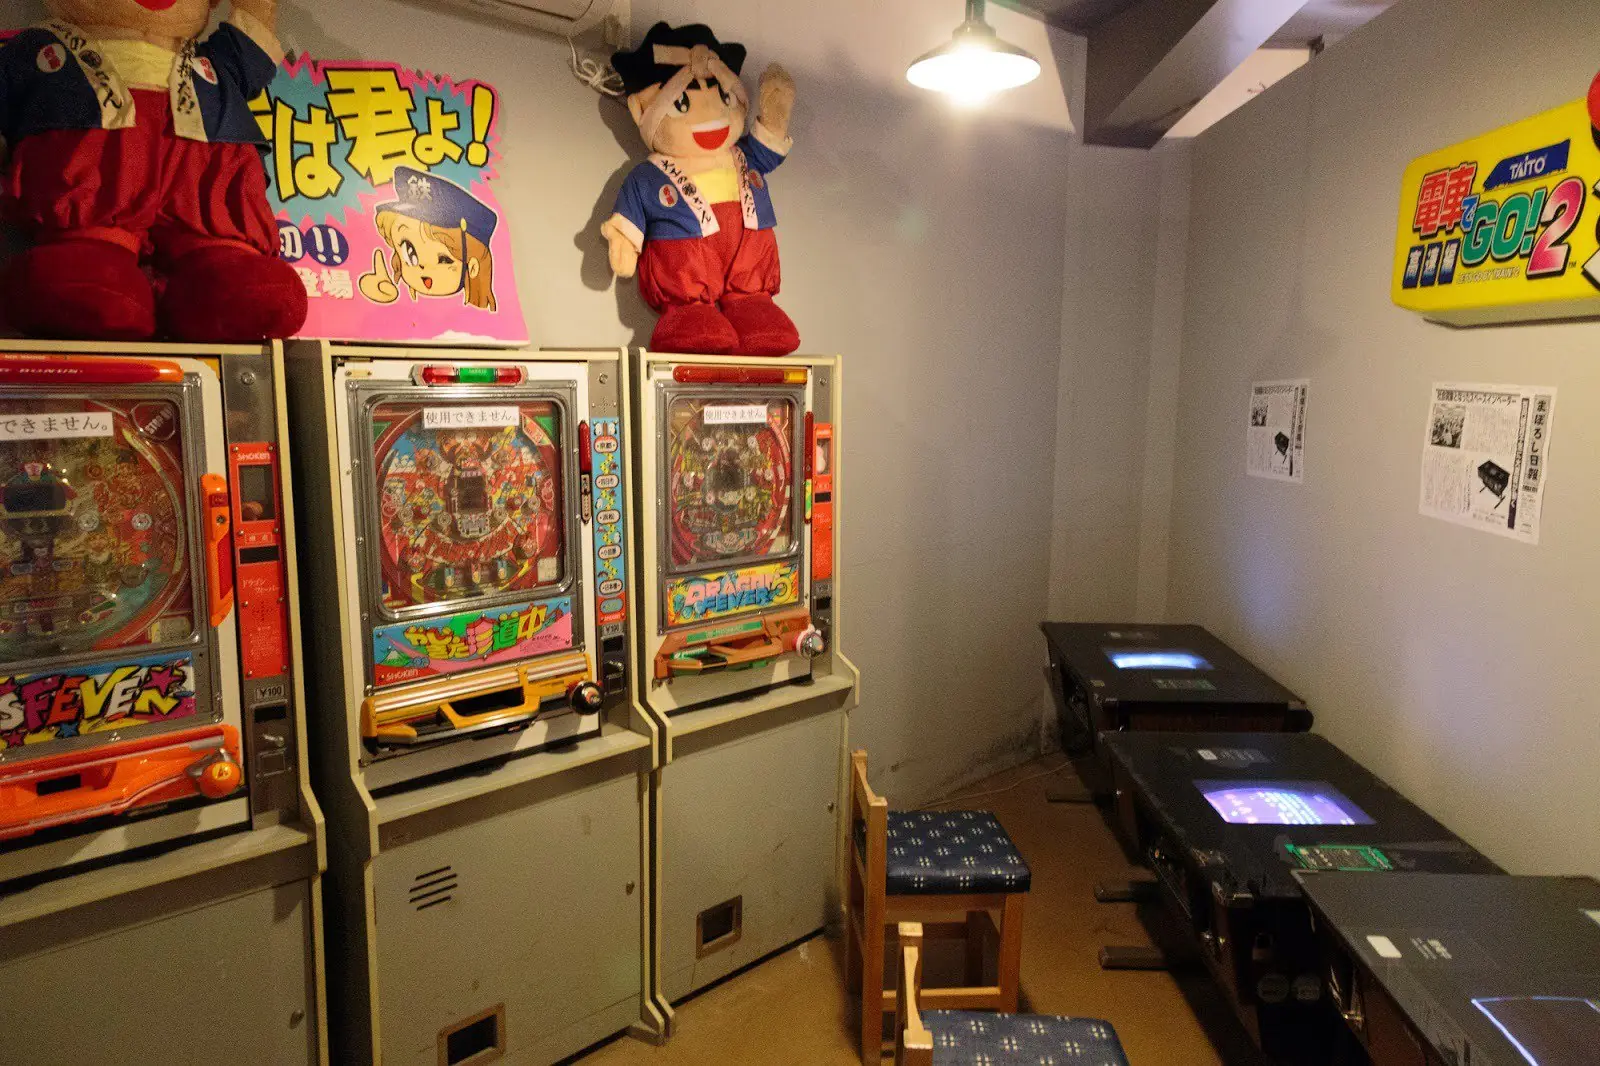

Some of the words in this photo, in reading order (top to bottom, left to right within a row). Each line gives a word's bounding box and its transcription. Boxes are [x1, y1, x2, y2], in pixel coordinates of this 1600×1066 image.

[1509, 152, 1548, 182] TAITO
[425, 409, 518, 424] 使用できません。
[1527, 399, 1548, 481] まぼろし日報
